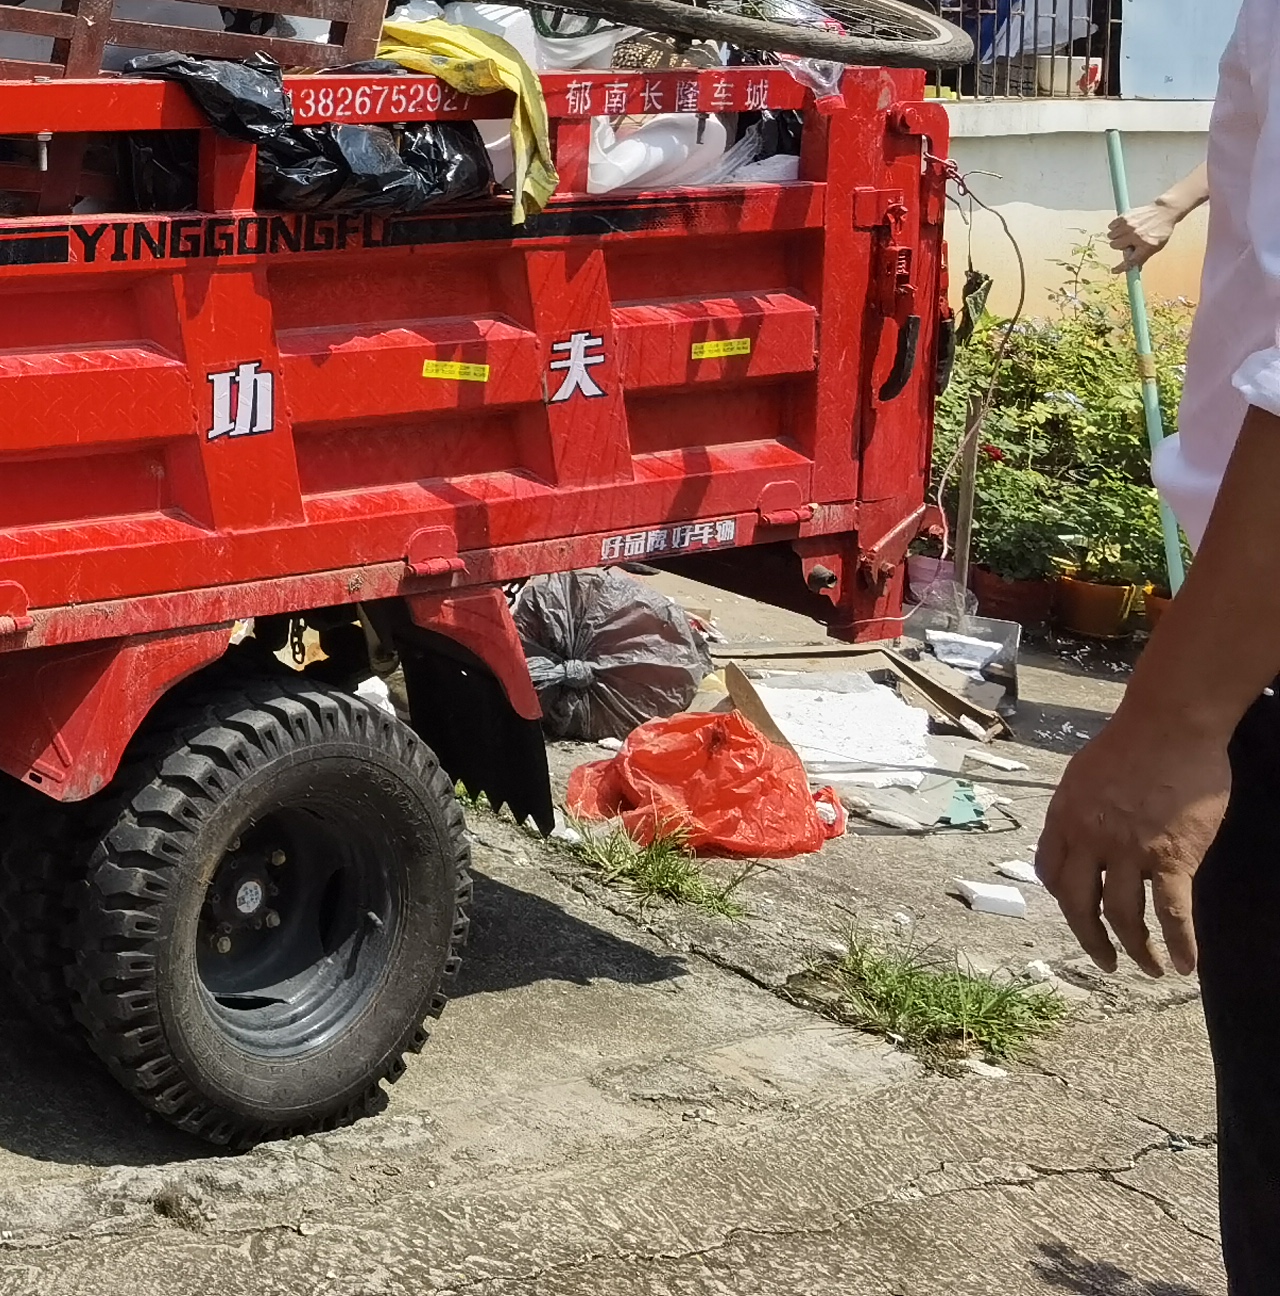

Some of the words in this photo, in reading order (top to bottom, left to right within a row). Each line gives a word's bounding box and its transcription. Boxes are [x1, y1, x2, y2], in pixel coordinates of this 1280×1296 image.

[566, 78, 769, 115] 郁南长隆车城
[71, 210, 392, 262] YINGGONGFU
[207, 361, 273, 440] 功
[549, 331, 606, 402] 夫
[600, 529, 668, 561] 好品牌
